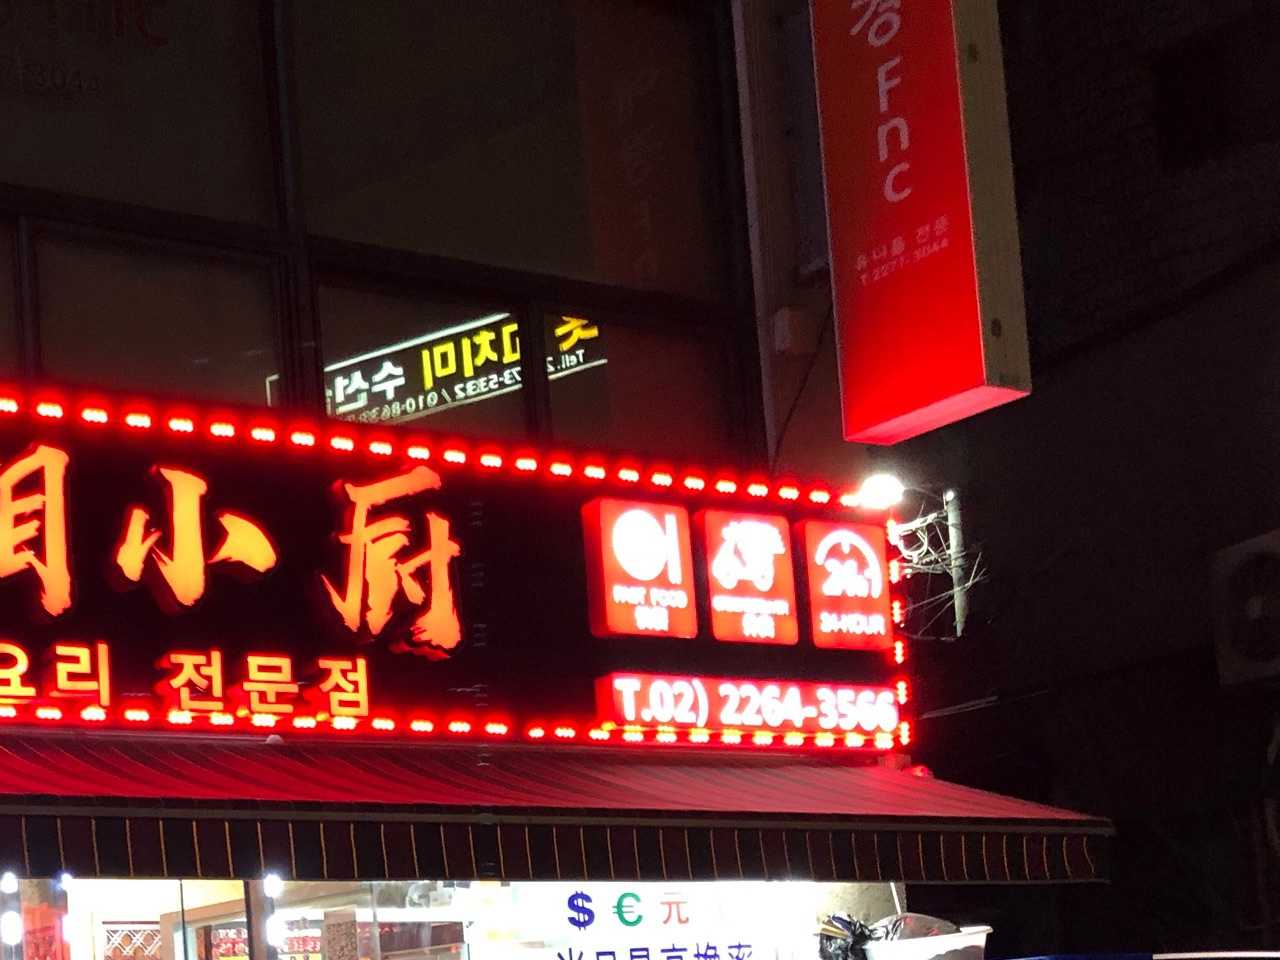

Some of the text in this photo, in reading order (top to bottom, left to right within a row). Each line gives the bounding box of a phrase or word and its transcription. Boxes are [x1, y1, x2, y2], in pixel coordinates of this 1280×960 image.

[876, 55, 913, 203] Fnc
[169, 650, 372, 718] 전문점
[614, 677, 899, 733] T.02) 2264-3566
[659, 891, 691, 926] 元
